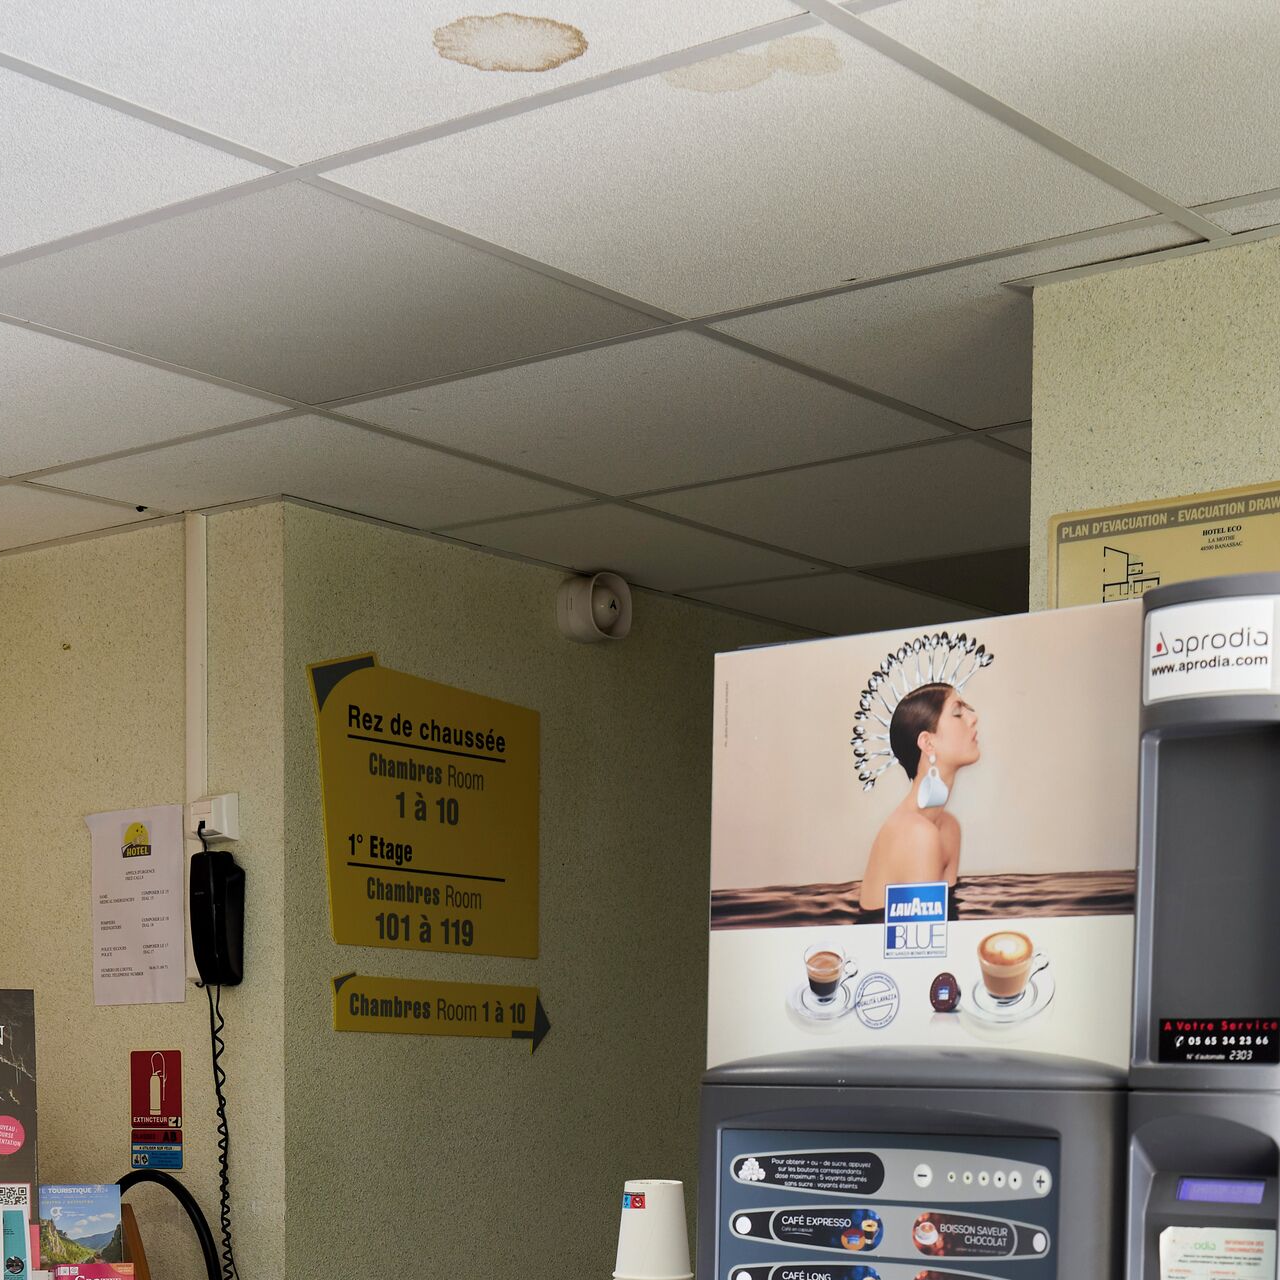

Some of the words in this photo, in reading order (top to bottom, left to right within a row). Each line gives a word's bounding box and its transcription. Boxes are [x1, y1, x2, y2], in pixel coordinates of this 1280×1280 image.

[1062, 524, 1089, 538] PLAN
[1092, 513, 1167, 533] D'EVACUATION
[1178, 502, 1245, 522] EVACUATION
[1203, 526, 1225, 536] HOTEL
[1215, 541, 1243, 550] BANASSAC
[1172, 627, 1268, 657] aprodia
[1152, 655, 1268, 676] www.aprodia.com
[348, 704, 384, 734] Rez
[390, 713, 412, 738] de
[420, 719, 506, 753] chaussée
[369, 752, 442, 785] Chambres
[447, 765, 484, 791] Room
[396, 792, 406, 818] 1
[415, 793, 426, 821] à
[436, 798, 459, 825] 10
[127, 846, 149, 856] HOTEL
[370, 836, 413, 865] Etage
[366, 877, 440, 906] Chambres
[445, 885, 482, 910] Room
[890, 898, 943, 917] LAVAZZA
[375, 913, 410, 941] 101
[420, 919, 431, 943] à
[441, 919, 473, 947] 119
[887, 924, 945, 949] BLUE
[349, 993, 431, 1019] Chambres
[436, 999, 477, 1022] Room
[482, 1001, 489, 1022] 1
[495, 1001, 504, 1023] à
[509, 1003, 526, 1024] 10
[1164, 1022, 1172, 1031] A
[1177, 1022, 1214, 1030] Votre
[1221, 1021, 1278, 1030] Service
[1188, 1036, 1201, 1045] 05
[1205, 1036, 1217, 1045] 65
[1222, 1036, 1235, 1045] 34
[1239, 1036, 1251, 1045] 23
[1255, 1036, 1268, 1045] 66
[1229, 1050, 1252, 1060] 2303
[782, 1214, 804, 1225] CAFÉ
[806, 1216, 851, 1228] EXPRESSO
[940, 1224, 975, 1234] BOISSON
[977, 1225, 1008, 1237] SAVEUR
[965, 1236, 1007, 1247] CHOCOLAT
[782, 1270, 805, 1280] CAFÉ
